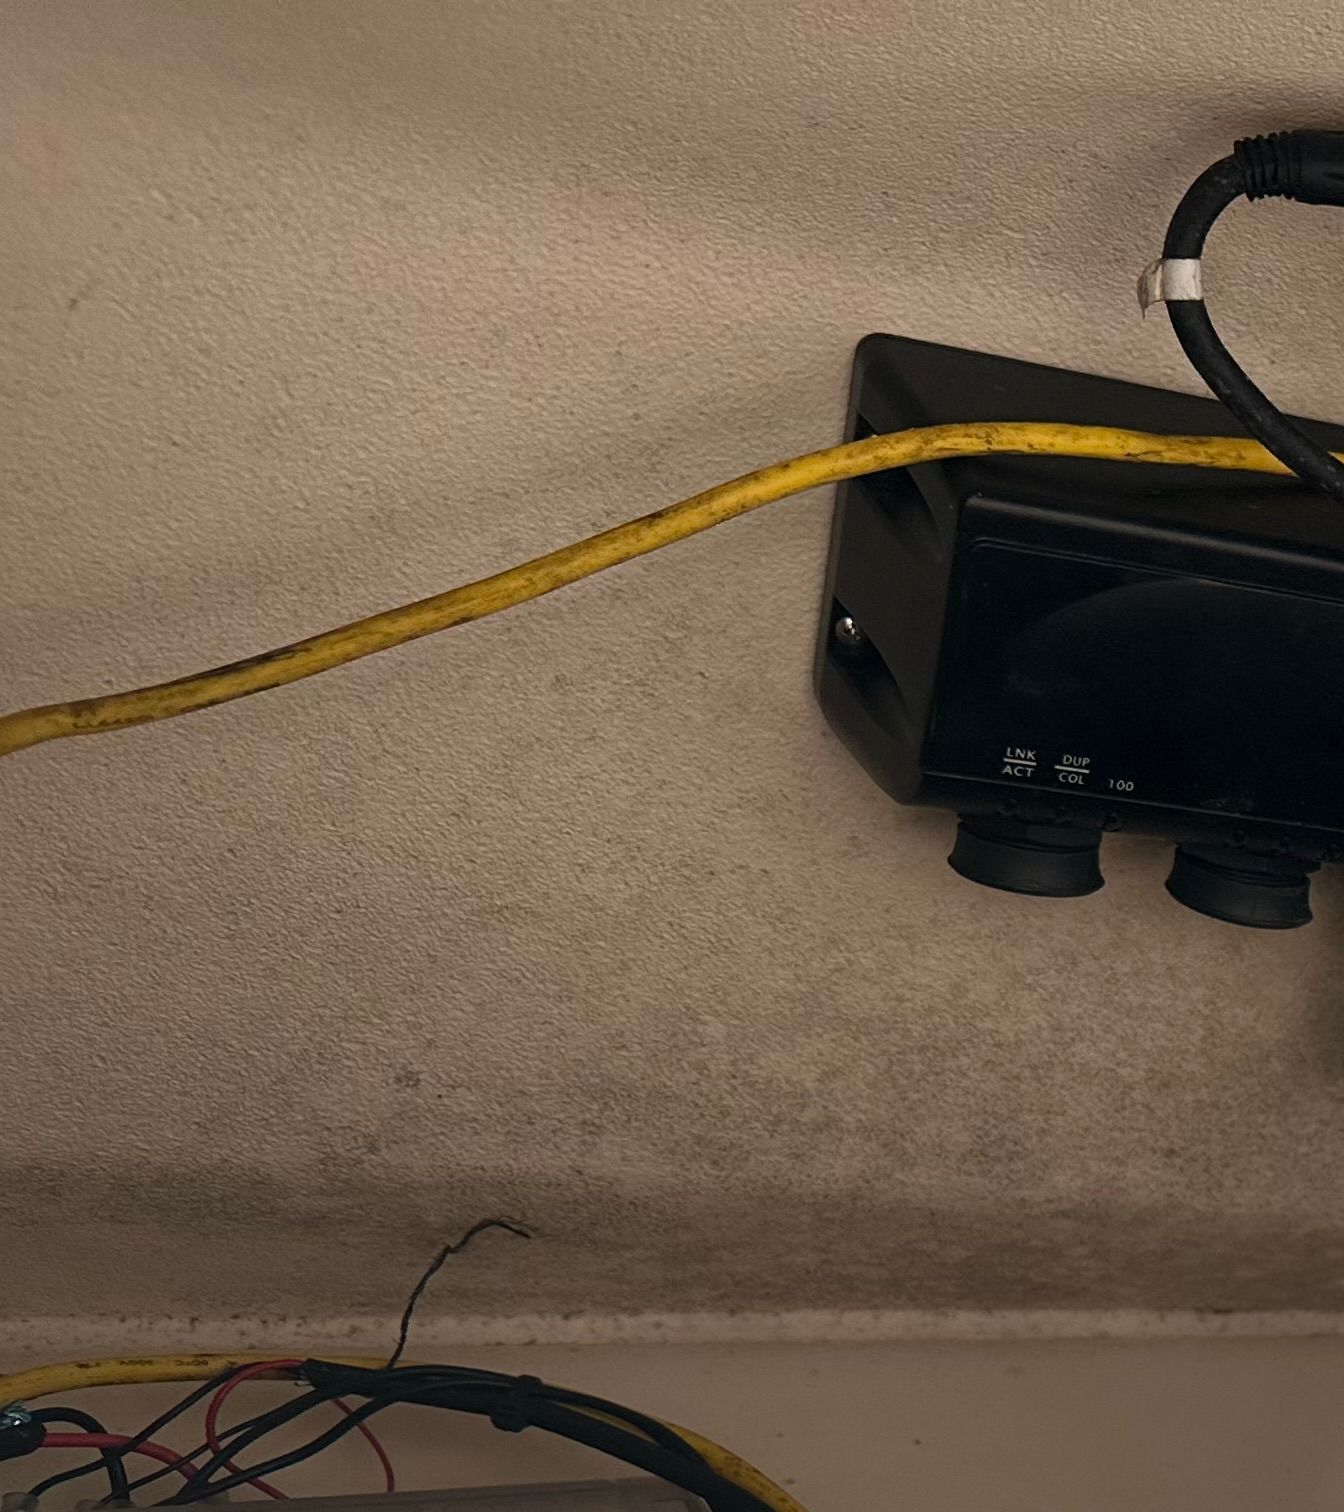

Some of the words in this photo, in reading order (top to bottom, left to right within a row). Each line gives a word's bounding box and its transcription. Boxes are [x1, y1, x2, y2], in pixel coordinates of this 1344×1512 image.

[1006, 747, 1037, 760] LNK
[1062, 754, 1091, 767] DUP
[1001, 765, 1035, 778] ACT
[1058, 772, 1084, 785] COL
[1108, 779, 1134, 792] 100
